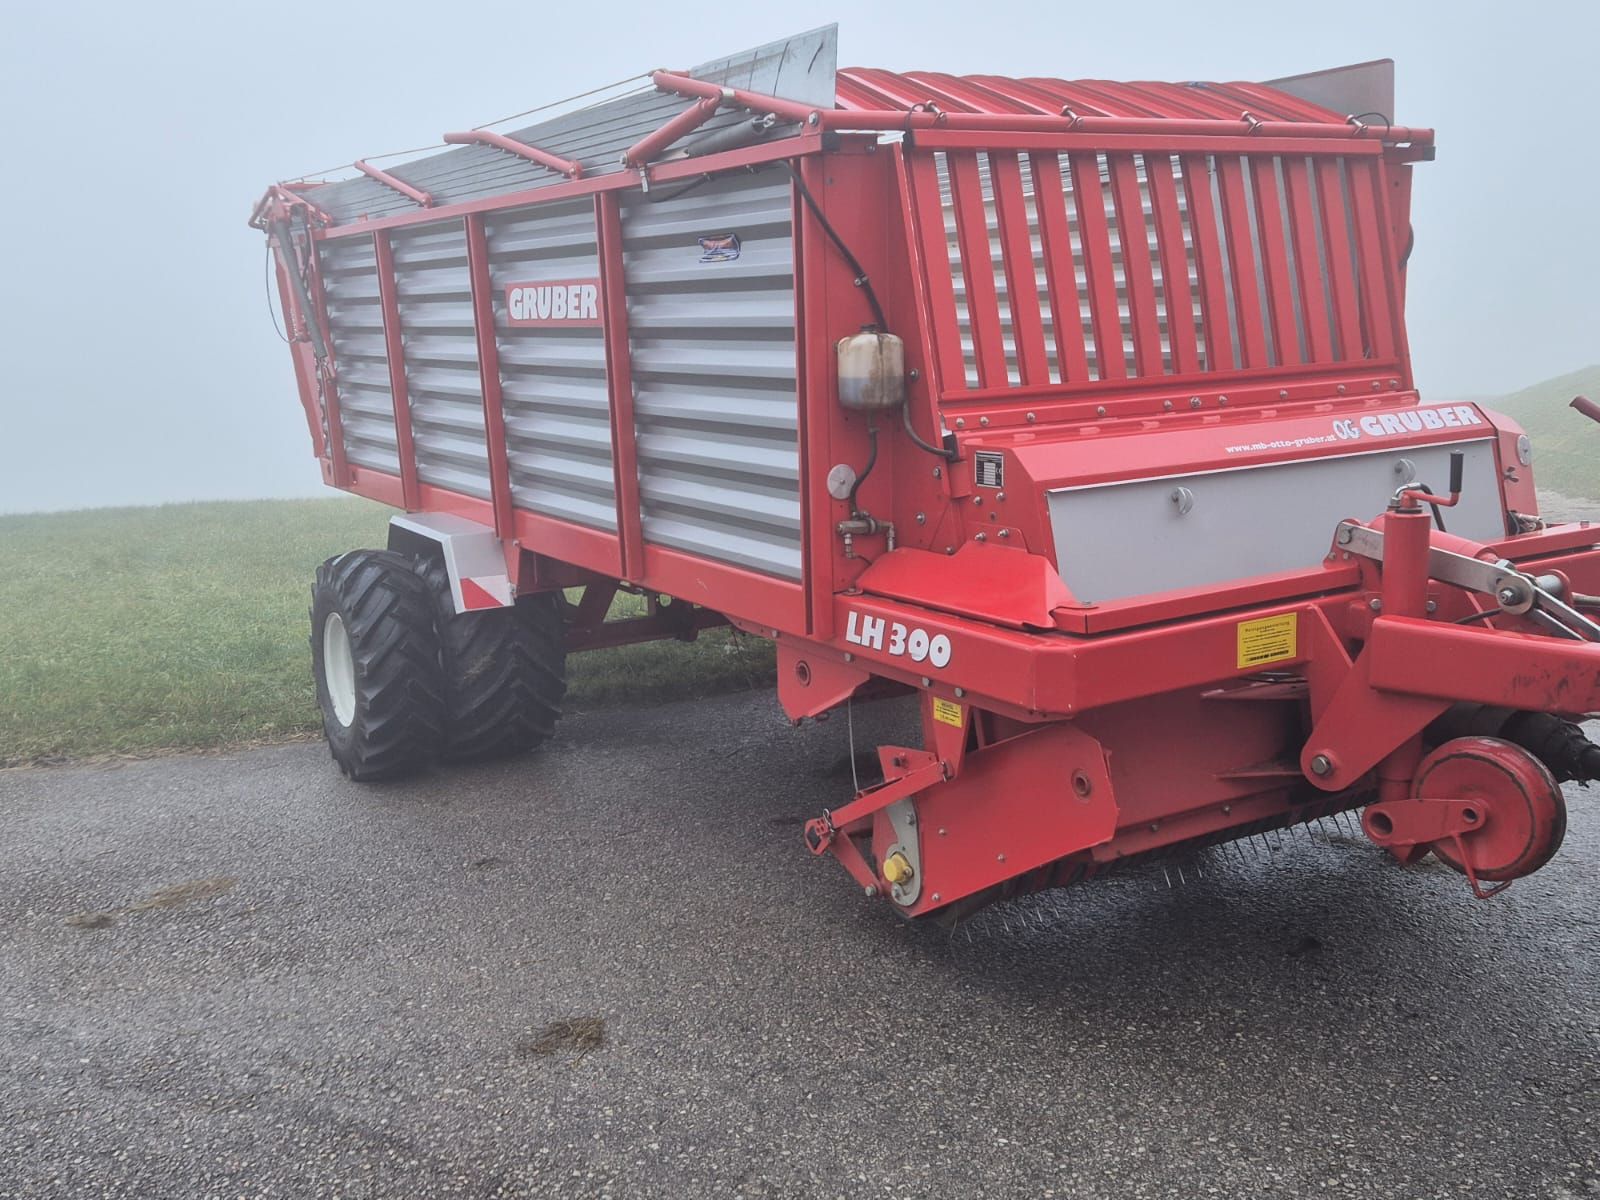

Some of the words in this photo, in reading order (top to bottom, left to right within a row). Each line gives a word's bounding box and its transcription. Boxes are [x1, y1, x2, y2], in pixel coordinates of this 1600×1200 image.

[510, 285, 598, 320] GRUBER
[1360, 406, 1481, 437] GRUBER
[1226, 435, 1337, 454] www.mb-otto-gruber.at
[846, 611, 885, 650] LH
[889, 622, 951, 667] 300
